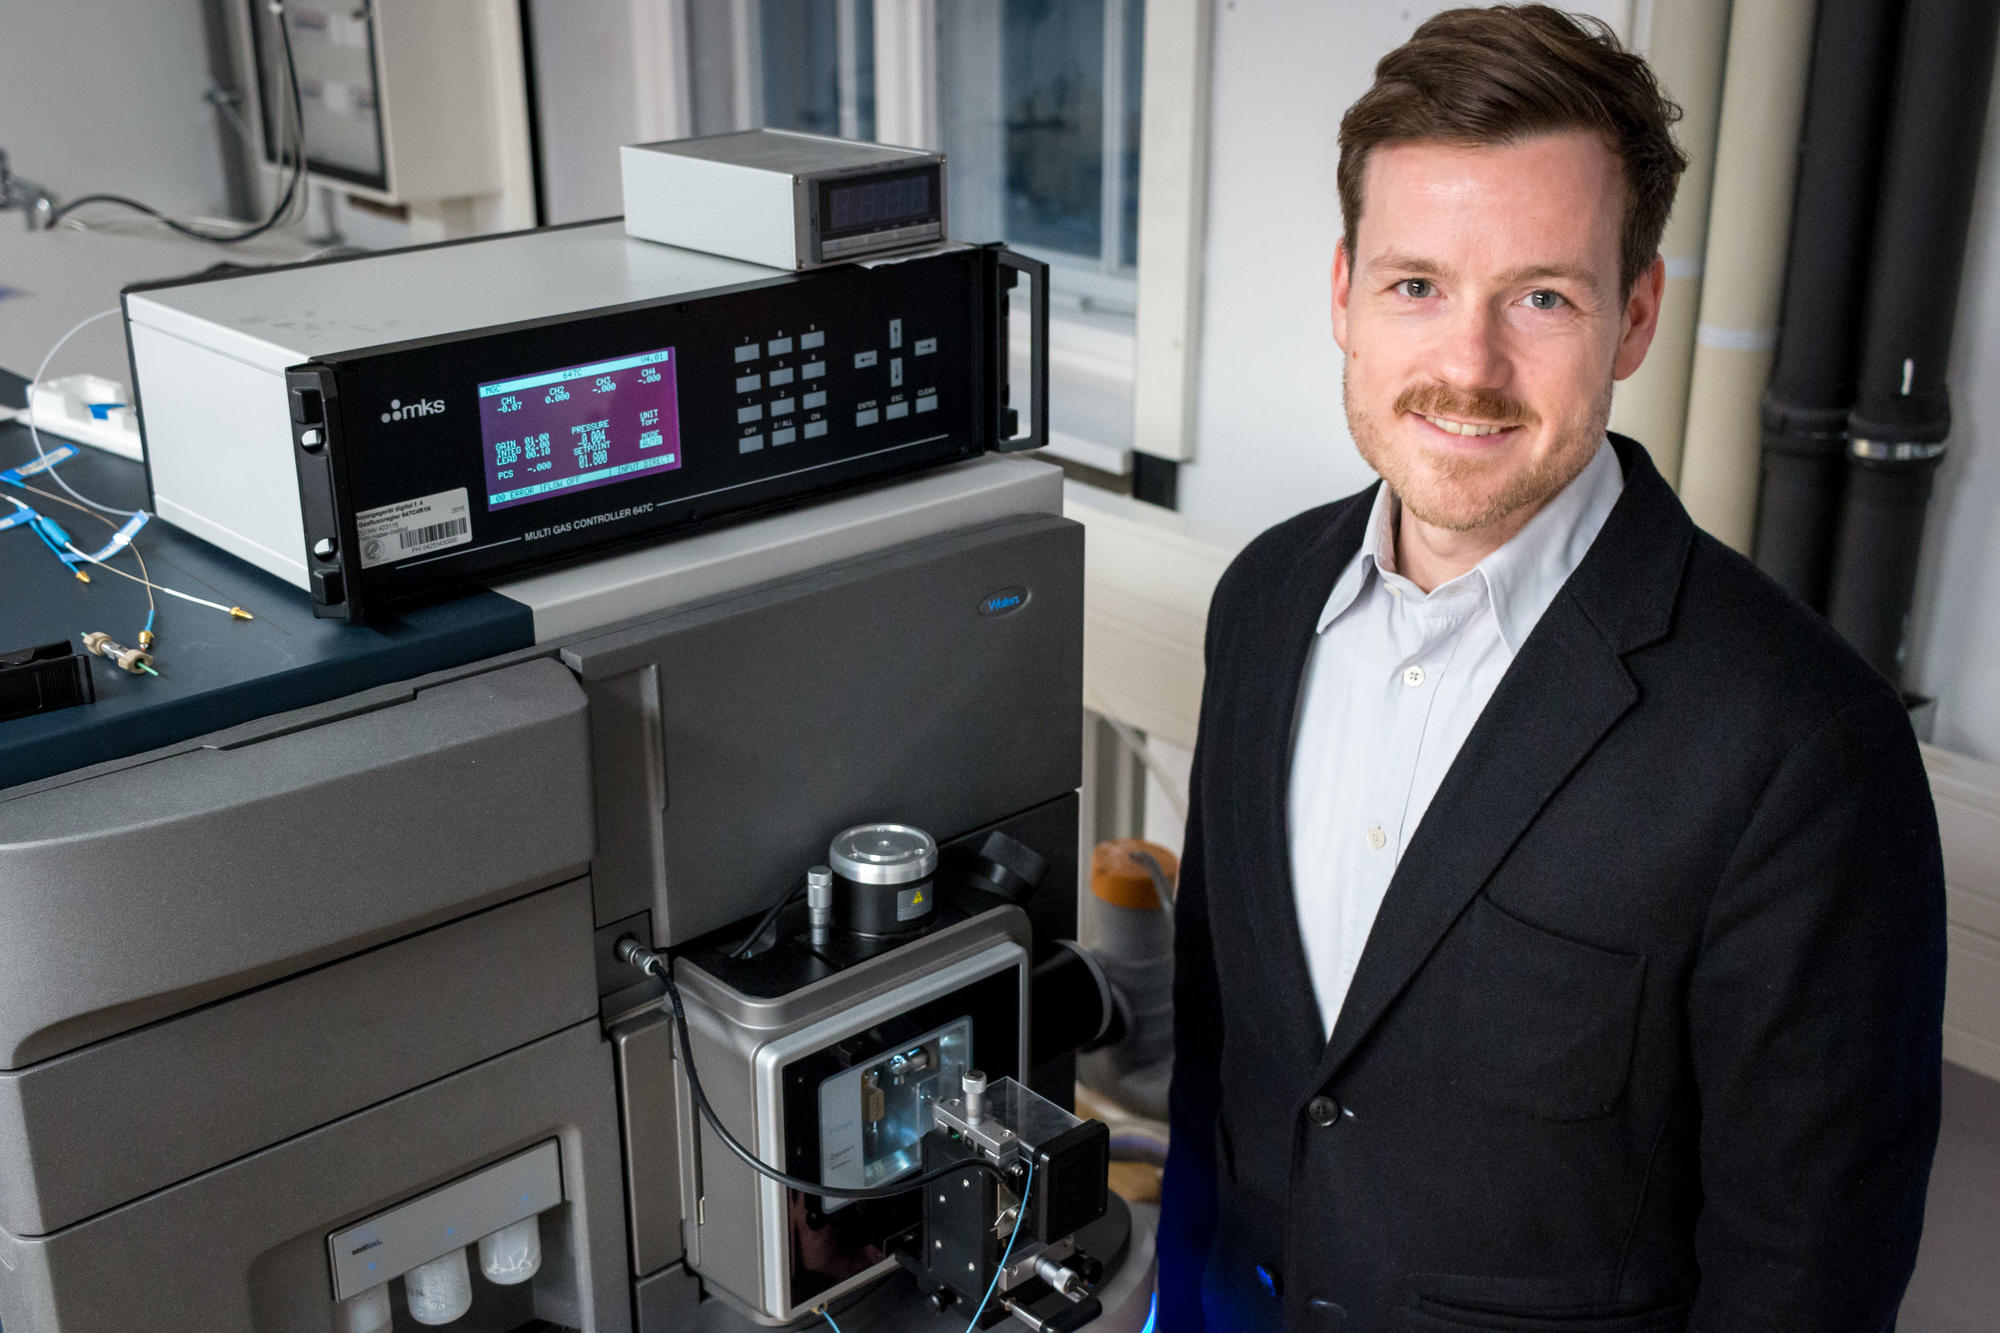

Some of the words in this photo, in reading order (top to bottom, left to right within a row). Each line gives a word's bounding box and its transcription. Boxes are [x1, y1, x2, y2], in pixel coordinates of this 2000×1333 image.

[486, 385, 501, 394] MGC
[563, 369, 582, 378] 647C
[501, 396, 516, 406] CH1
[549, 386, 565, 396] CH2
[596, 376, 611, 386] CH3
[641, 368, 656, 377] CH4
[917, 387, 936, 397] CLEAR
[402, 398, 446, 420] mks
[497, 402, 522, 413] -0.07
[858, 400, 877, 411] ENTER
[640, 409, 659, 421] UNIT
[810, 413, 821, 421] ON
[571, 419, 610, 435] PRESSURE
[641, 417, 659, 427] Torr
[744, 426, 757, 436] OFF
[496, 440, 517, 451] GAIN
[573, 441, 611, 456] SETPOINT
[497, 447, 521, 458] INTEG
[496, 455, 517, 466] LEAD
[496, 493, 506, 503] 00
[511, 488, 534, 499] ERROR
[543, 481, 563, 492] FLOW
[567, 477, 581, 487] OFF
[618, 464, 640, 475] INPUT
[644, 457, 671, 469] DIRECT
[498, 470, 514, 480] PCS
[395, 502, 414, 513] digital
[524, 527, 551, 542] MULTI
[553, 523, 572, 535] GAS
[574, 508, 632, 530] CONTROLLER
[633, 503, 654, 516] 647C
